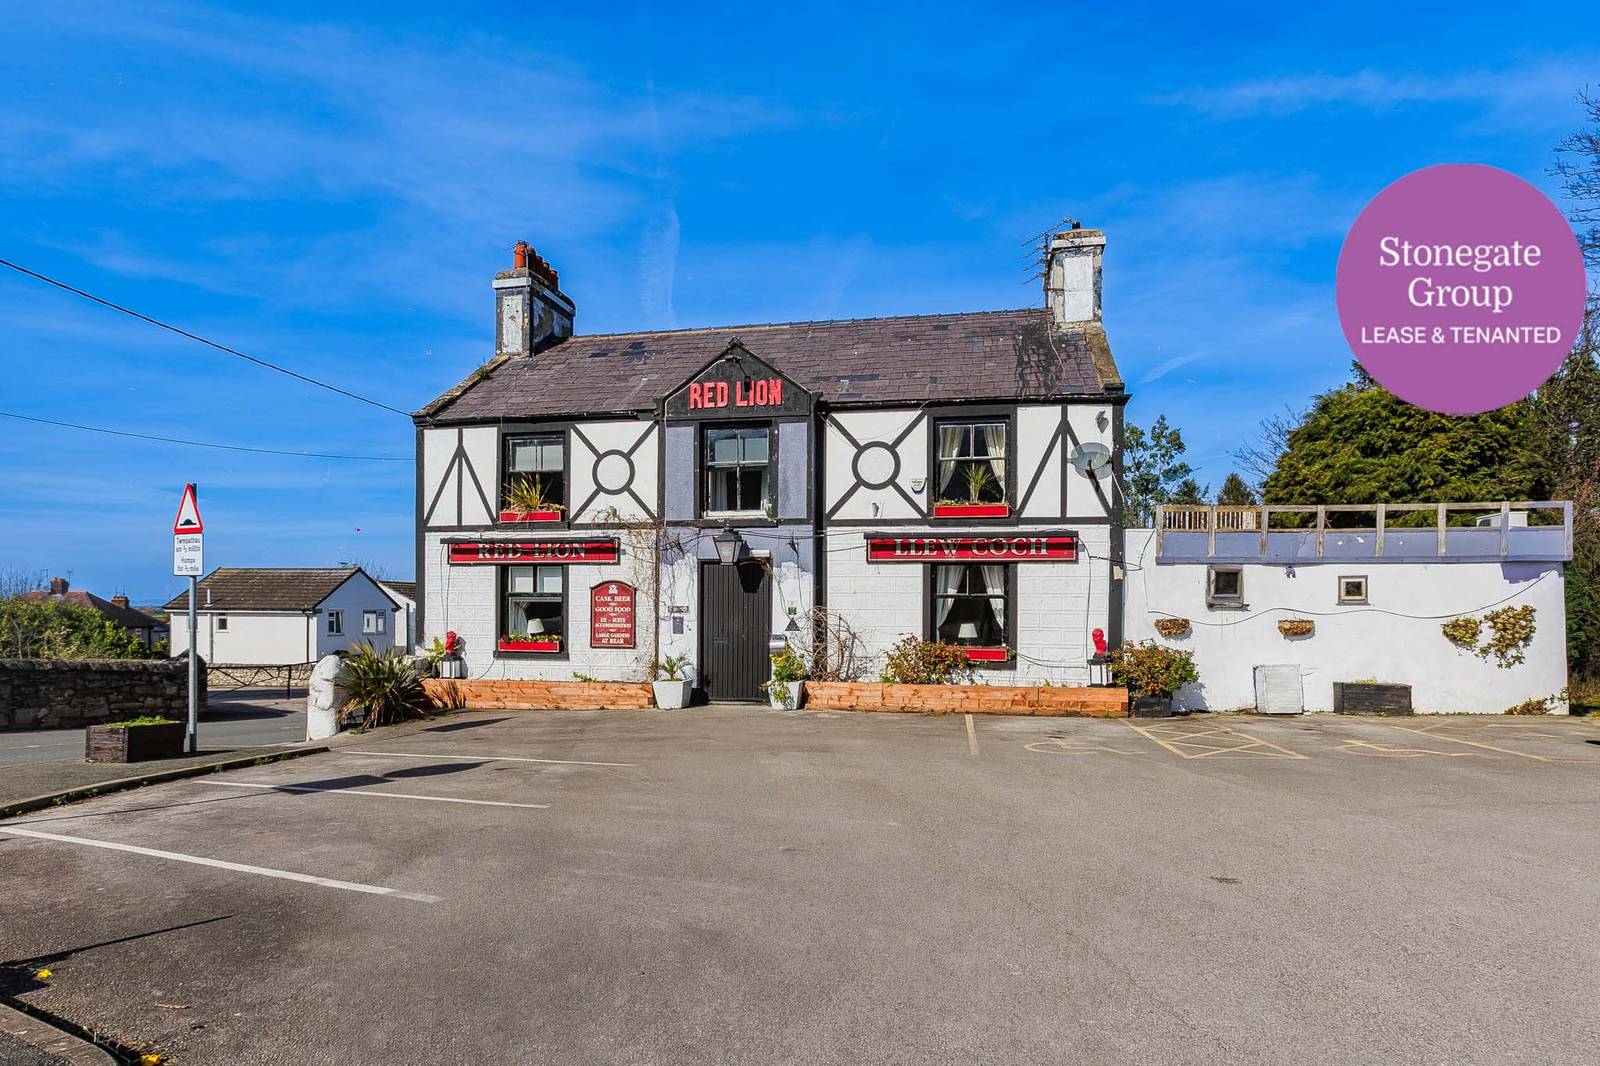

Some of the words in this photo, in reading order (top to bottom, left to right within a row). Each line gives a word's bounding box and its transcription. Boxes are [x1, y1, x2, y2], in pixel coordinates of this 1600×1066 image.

[689, 381, 729, 409] RED
[735, 379, 783, 407] LION
[477, 543, 523, 559] RED
[533, 543, 586, 559] LION
[894, 539, 960, 556] LLEW
[971, 537, 1049, 556] COCH
